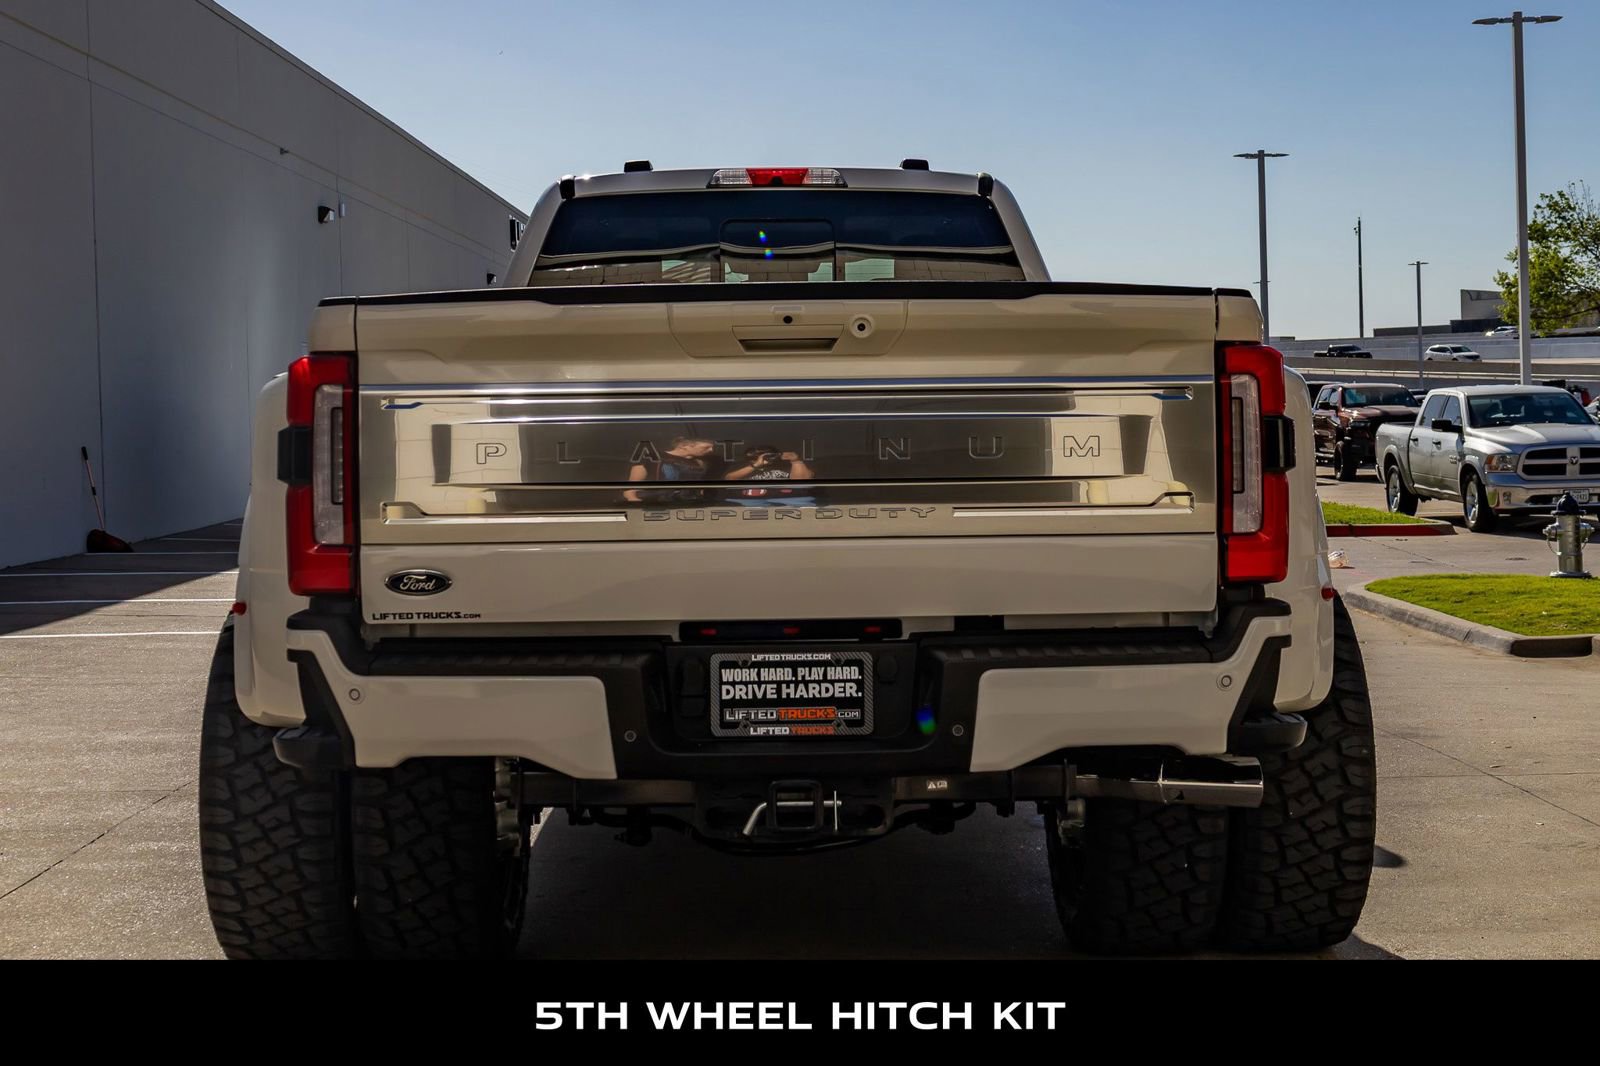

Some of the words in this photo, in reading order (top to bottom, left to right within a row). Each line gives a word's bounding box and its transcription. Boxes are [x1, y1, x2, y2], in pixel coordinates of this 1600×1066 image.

[475, 434, 1101, 465] PLATINUM
[643, 509, 802, 522] SUPER
[815, 506, 936, 520] DUTY
[400, 575, 436, 590] Ford
[721, 668, 759, 682] WORK
[760, 667, 796, 681] HARD.
[797, 667, 825, 680] PLAY
[827, 666, 862, 680] HARD.
[721, 684, 778, 700] DRIVE
[781, 682, 863, 699] HARDER.
[750, 726, 790, 735] LIFTED
[791, 726, 834, 735] TRUCKS
